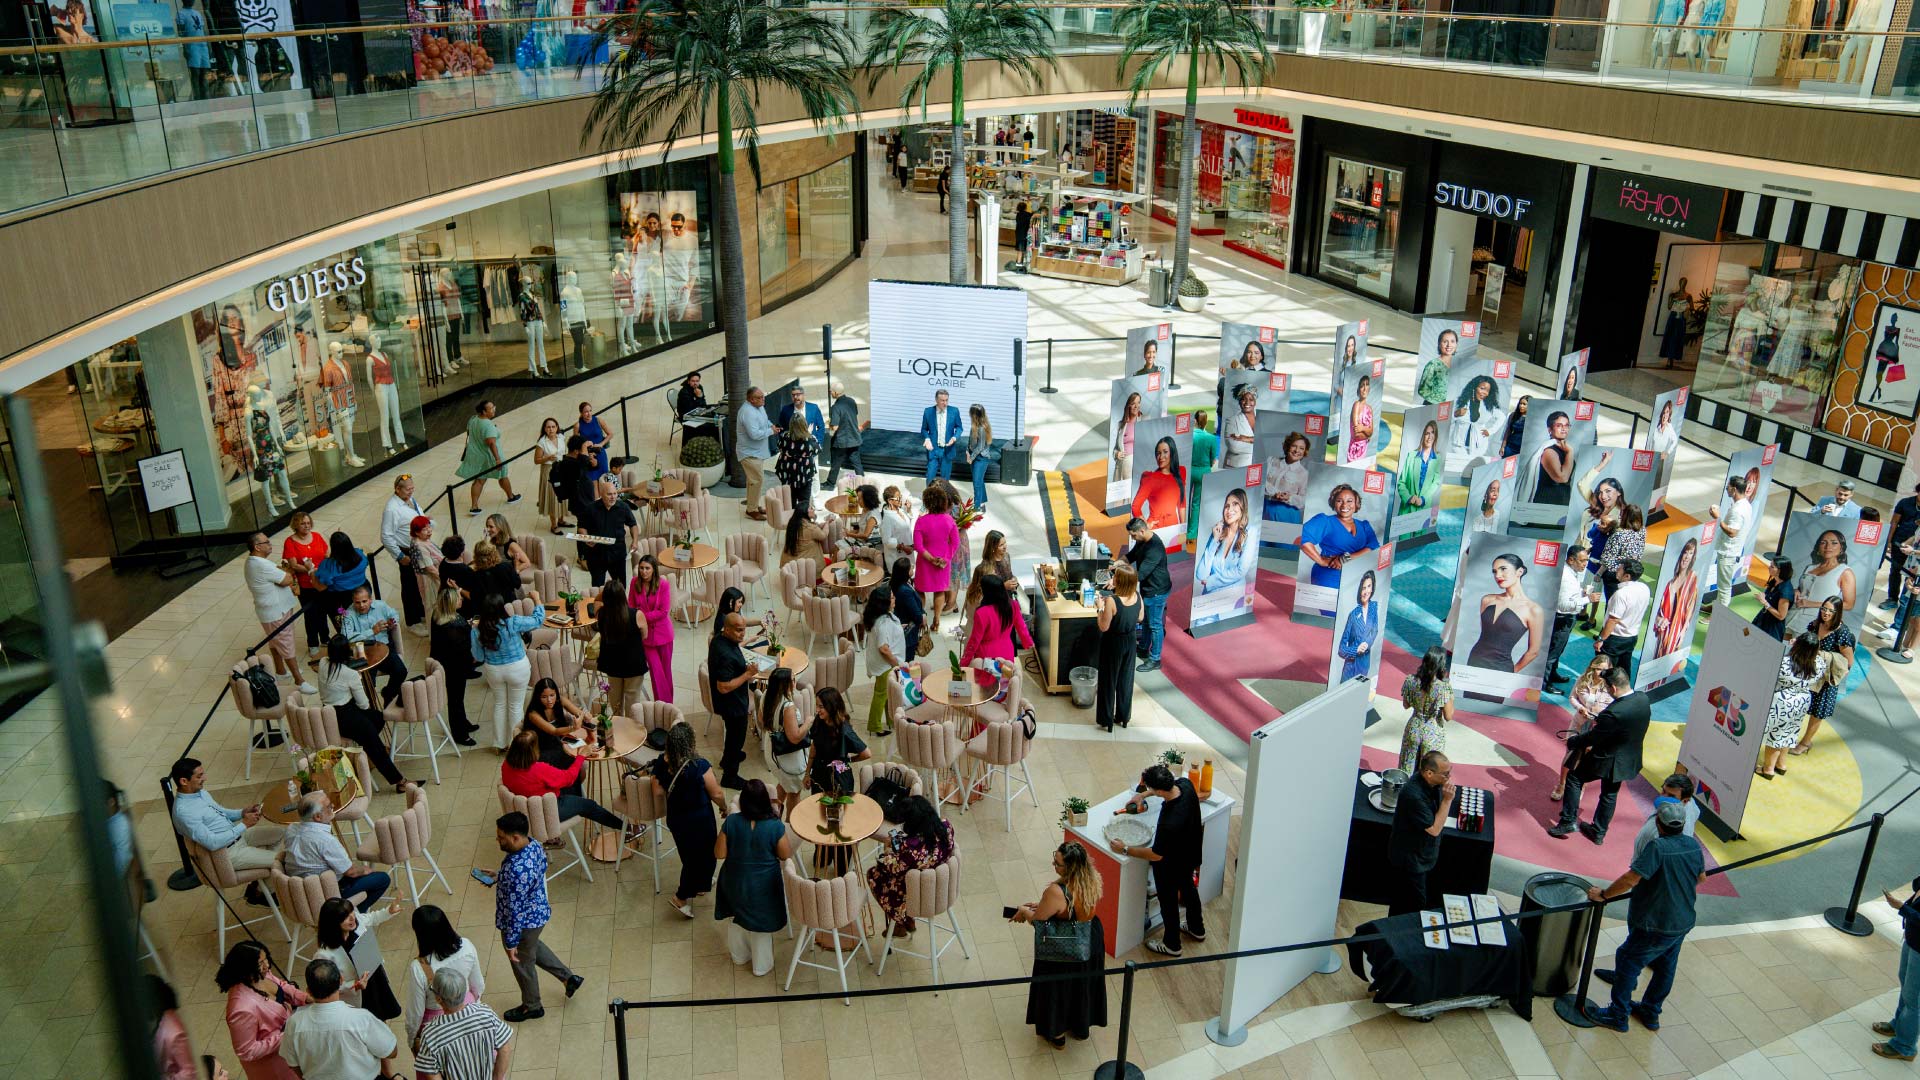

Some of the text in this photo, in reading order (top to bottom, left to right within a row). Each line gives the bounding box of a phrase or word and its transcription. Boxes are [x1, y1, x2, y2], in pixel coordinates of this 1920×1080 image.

[133, 23, 159, 34] SALE
[1199, 153, 1224, 177] SALE
[1272, 172, 1291, 198] SAL
[1622, 179, 1640, 189] the
[1434, 182, 1532, 221] STUDIO F
[1647, 212, 1687, 229] lounge
[267, 256, 366, 312] GUESS
[898, 357, 996, 381] L'ORÉAL
[927, 377, 967, 389] CARIBE
[314, 387, 356, 424] SALE
[153, 463, 172, 473] SALE
[161, 482, 175, 491] OFF
